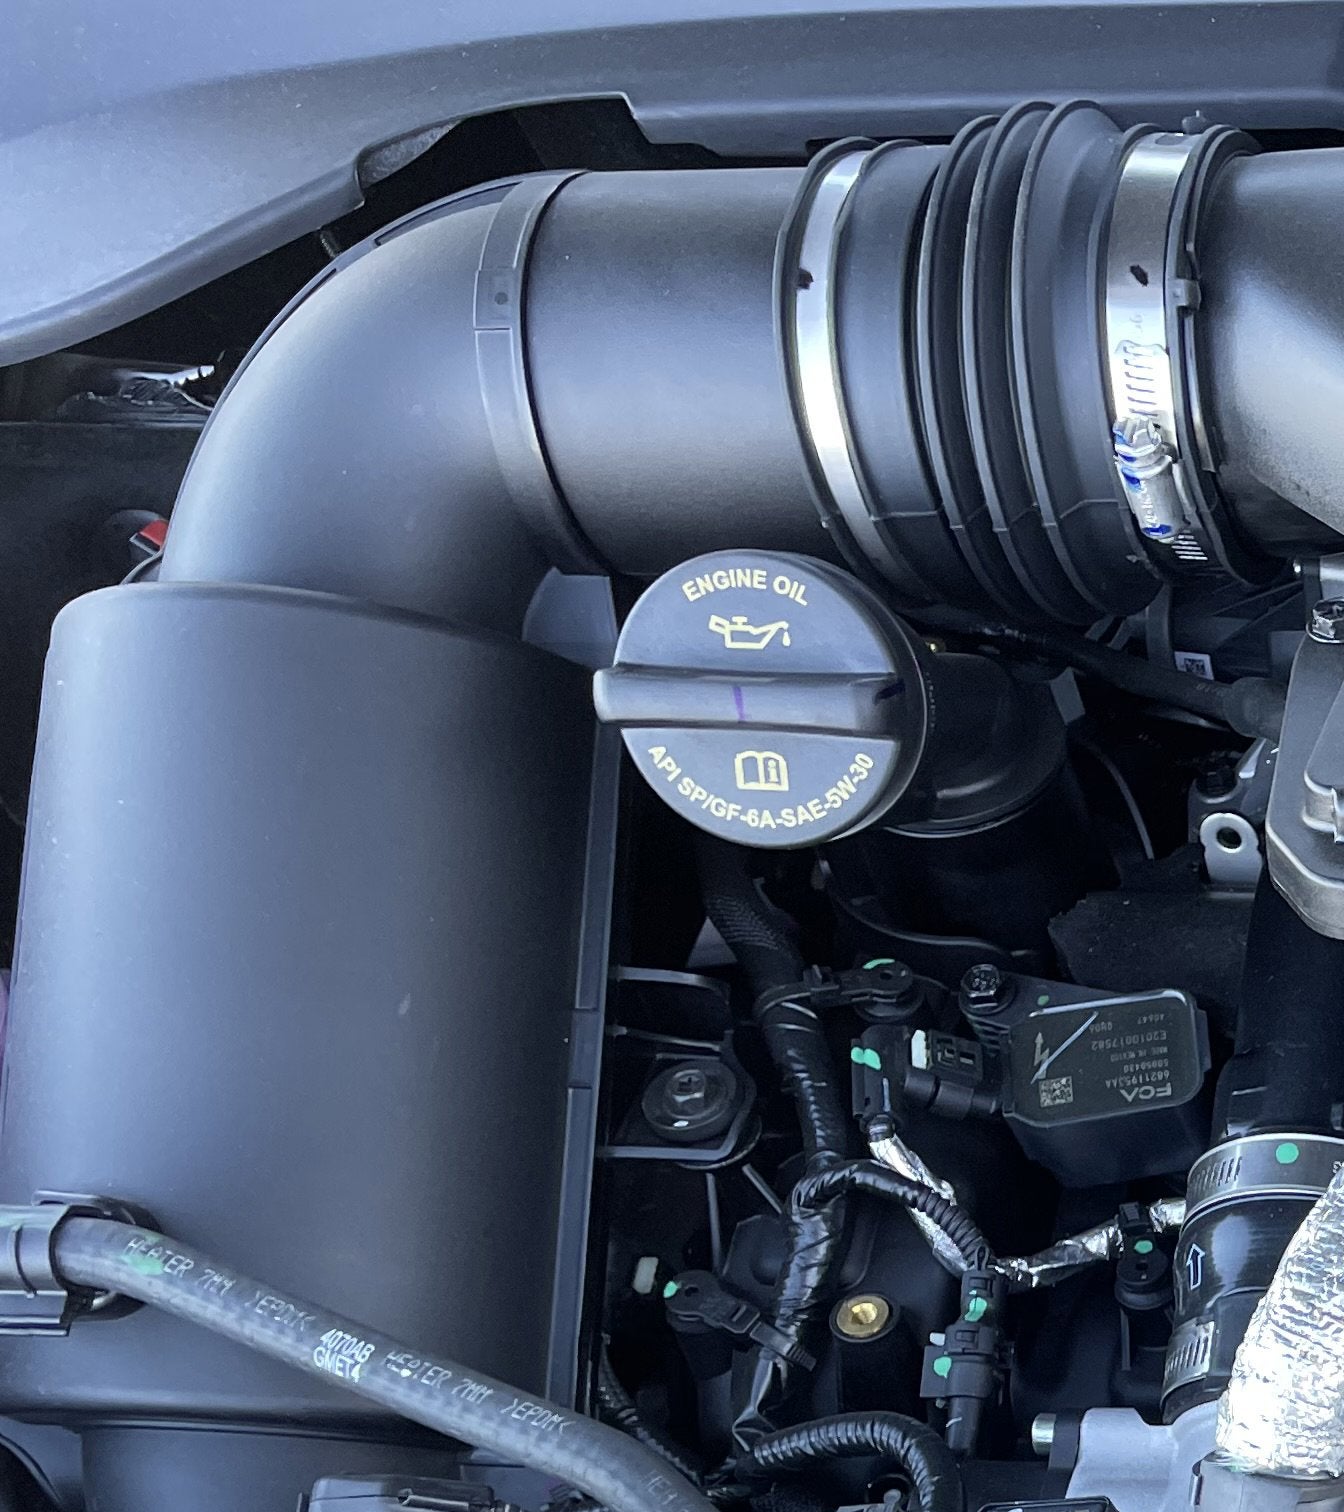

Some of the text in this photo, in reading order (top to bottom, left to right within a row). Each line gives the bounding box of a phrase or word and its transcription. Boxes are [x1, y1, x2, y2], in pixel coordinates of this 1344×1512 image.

[682, 568, 808, 606] ENGINE OIL
[647, 745, 676, 782] API
[1120, 1083, 1172, 1103] FCA
[123, 1238, 194, 1278] HEATER
[382, 1351, 452, 1389] HEATER
